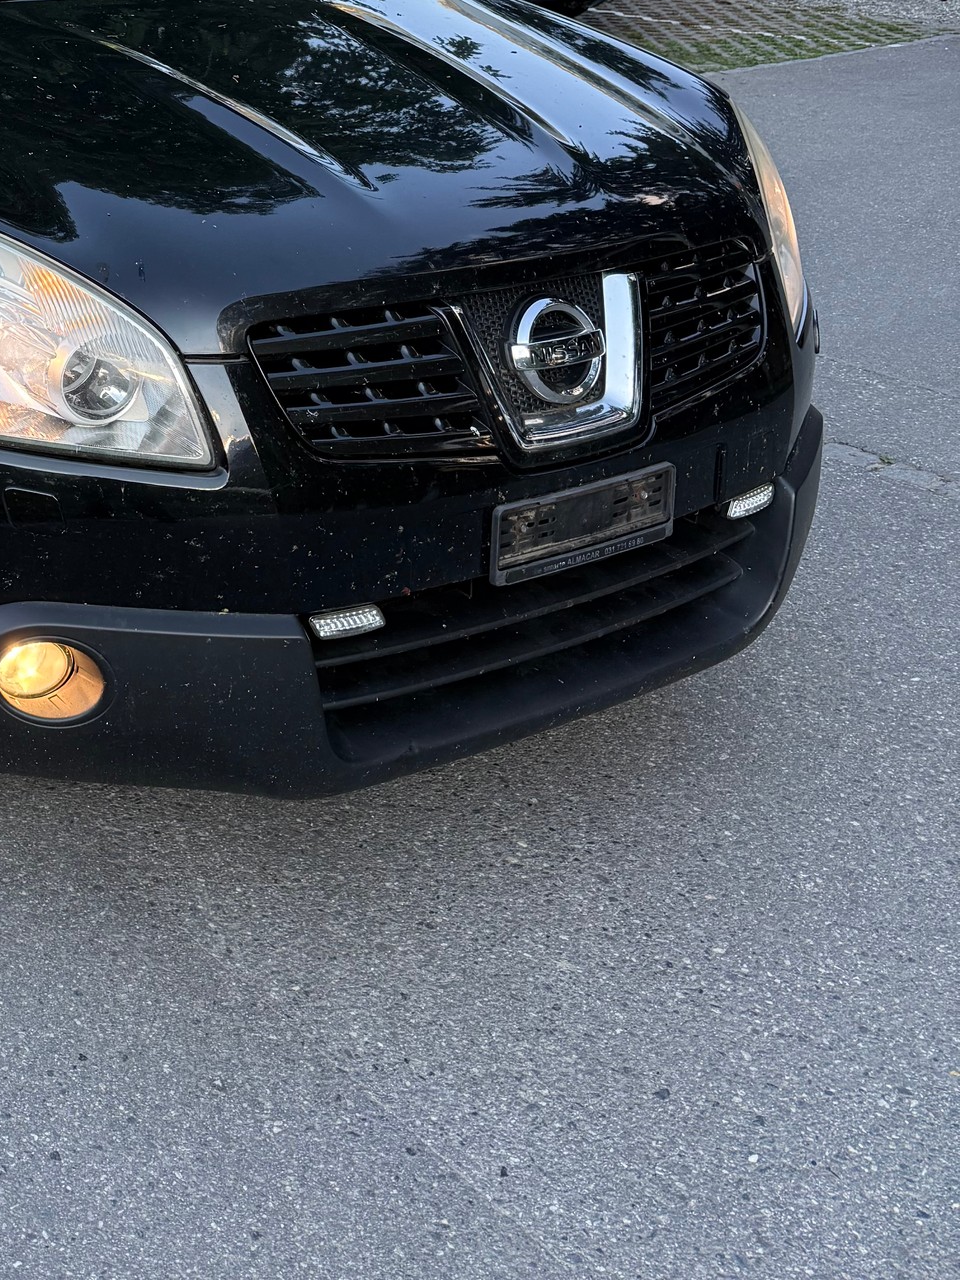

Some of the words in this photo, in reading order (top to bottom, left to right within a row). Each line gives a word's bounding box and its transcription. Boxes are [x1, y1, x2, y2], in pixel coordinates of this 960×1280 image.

[530, 334, 600, 366] NISSAN
[567, 550, 600, 565] ALMACAR
[604, 545, 615, 556] 031
